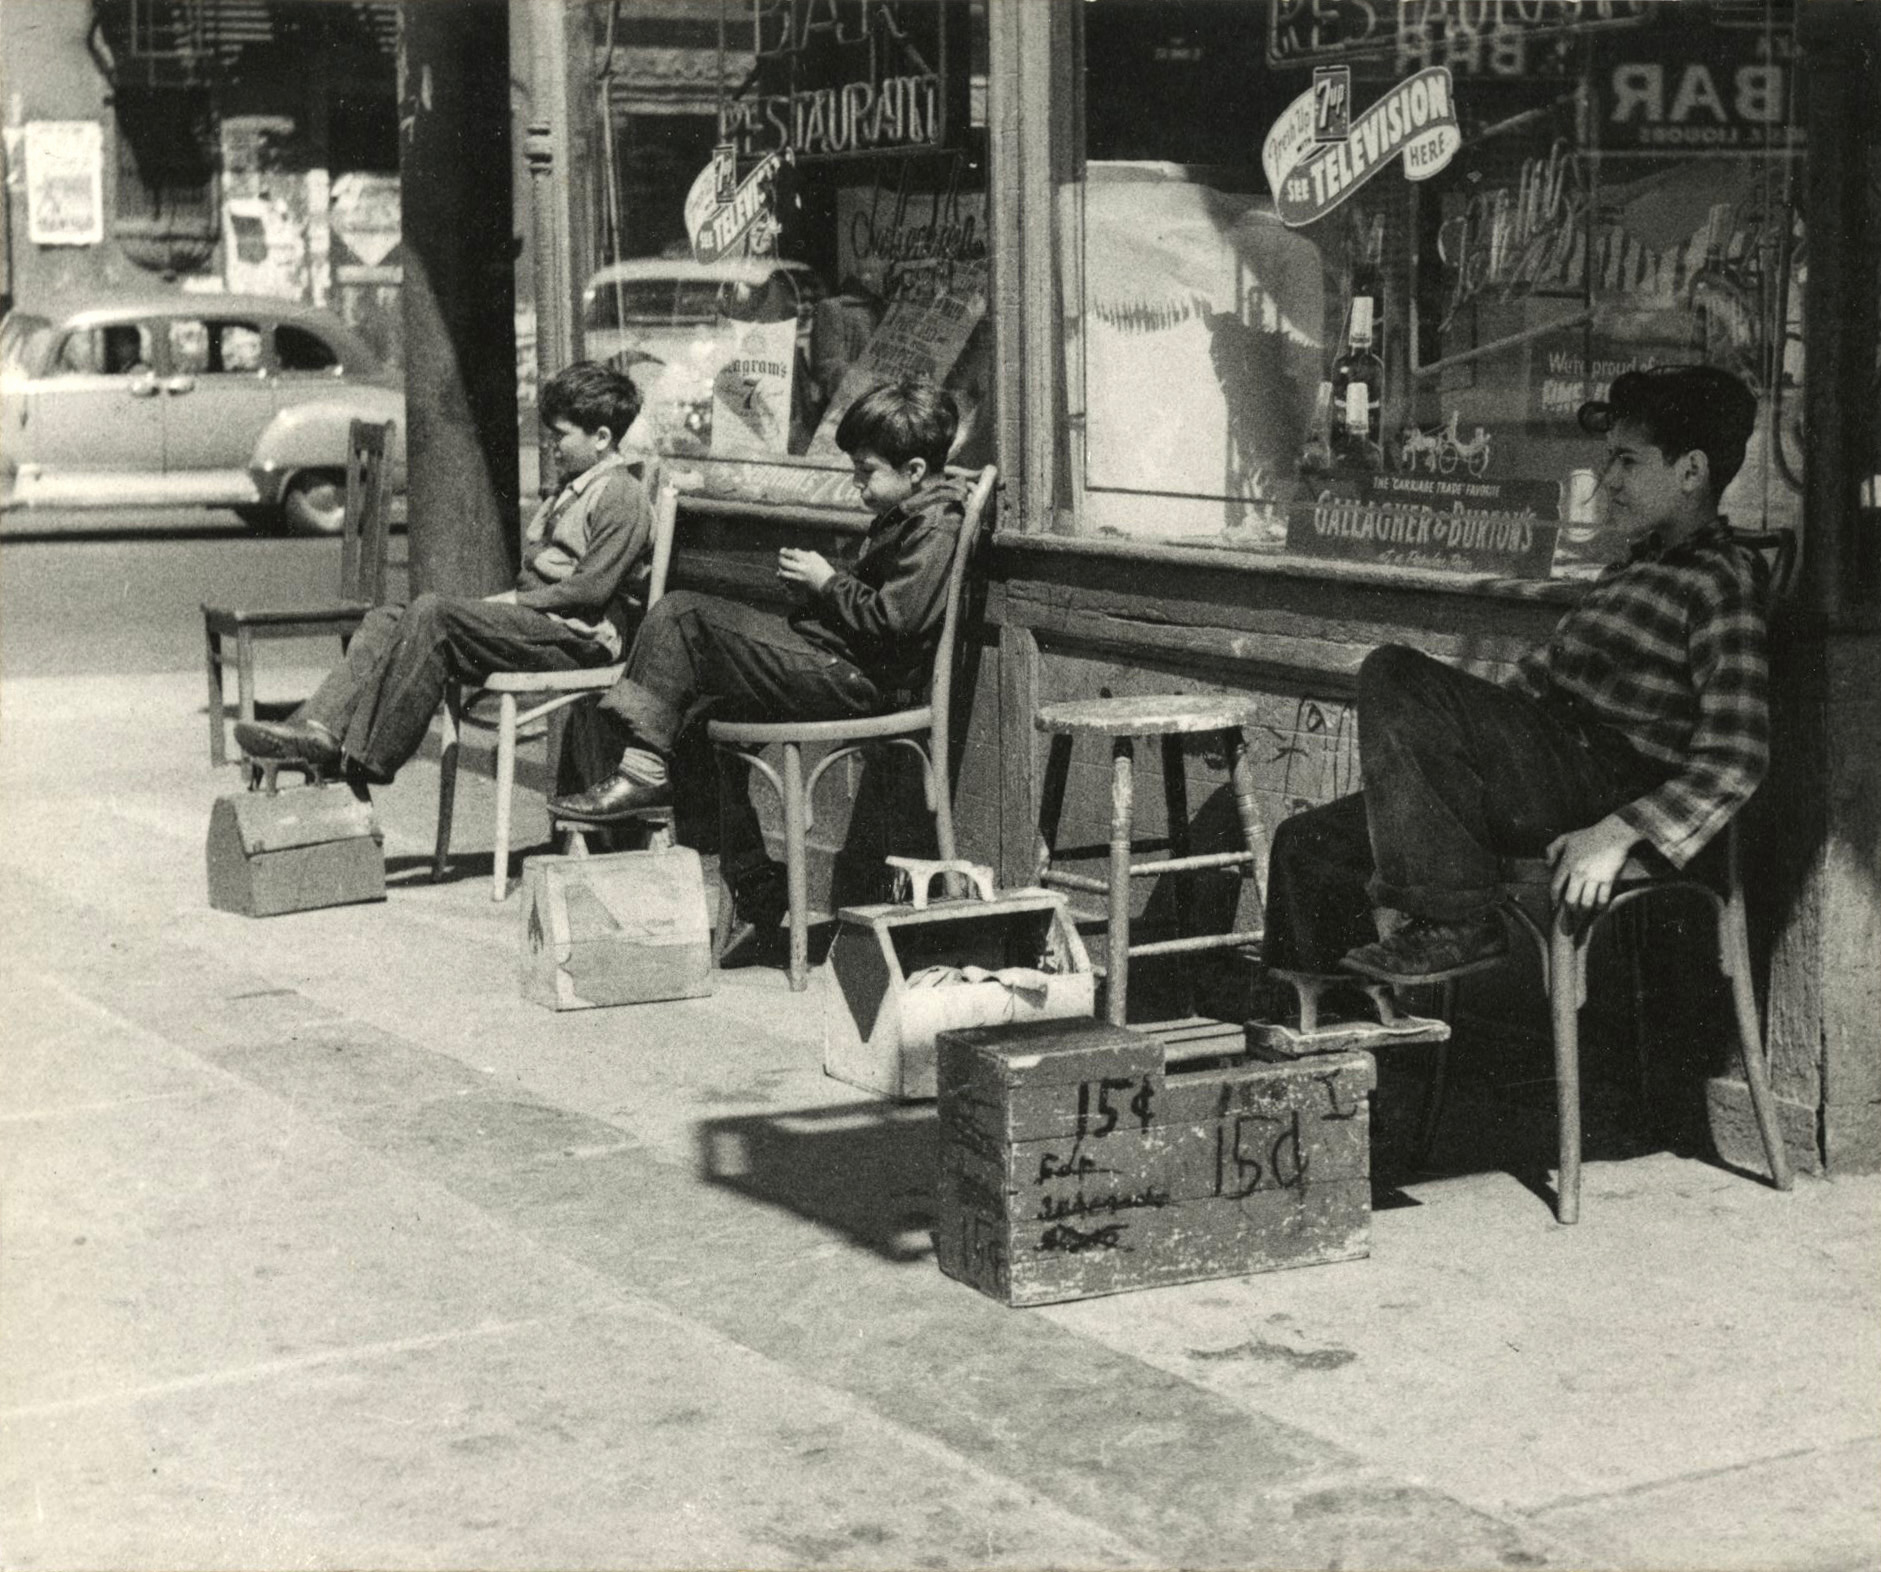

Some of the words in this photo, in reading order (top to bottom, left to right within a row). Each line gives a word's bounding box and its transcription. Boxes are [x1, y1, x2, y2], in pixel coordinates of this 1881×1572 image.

[1286, 178, 1310, 202] SEE
[1311, 75, 1449, 207] TELEVISION
[1409, 131, 1446, 168] HERE
[722, 359, 788, 379] agram's
[1373, 476, 1389, 491] THE
[1314, 490, 1433, 544] GALLAGHER
[1433, 511, 1449, 541] &
[1448, 501, 1536, 552] BURTON'S
[1076, 1073, 1156, 1141] 15¢
